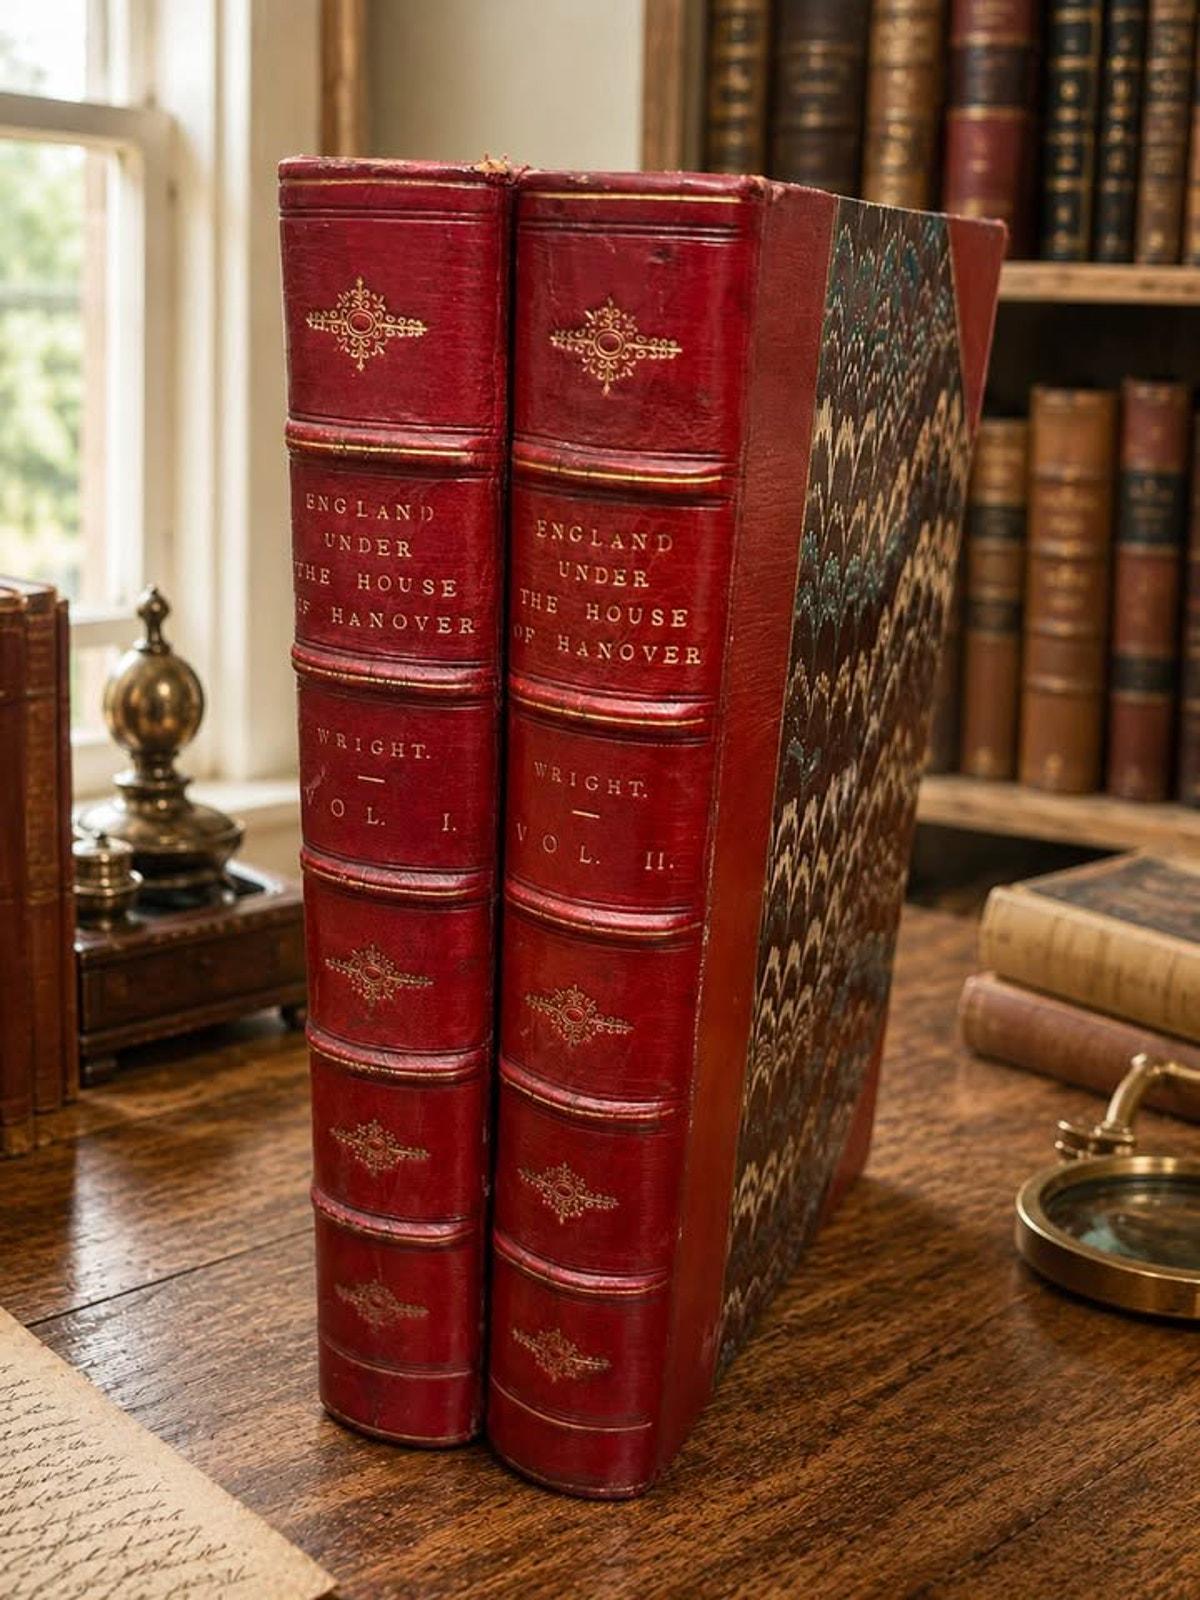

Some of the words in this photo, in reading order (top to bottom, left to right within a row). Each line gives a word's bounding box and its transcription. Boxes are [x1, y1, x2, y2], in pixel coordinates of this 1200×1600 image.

[306, 493, 435, 522] ENGLAND
[324, 532, 413, 558] UNDER
[536, 519, 674, 552] ENGLAND
[357, 573, 458, 598] HOUSE
[559, 560, 650, 588] UNDER
[331, 606, 476, 634] HANOVER
[520, 588, 559, 614] THE
[586, 602, 689, 628] HOUSE
[557, 634, 701, 664] HANOVER
[317, 727, 431, 760] WRIGHT.
[534, 761, 648, 798] WRIGHT.
[645, 852, 674, 870] II.
